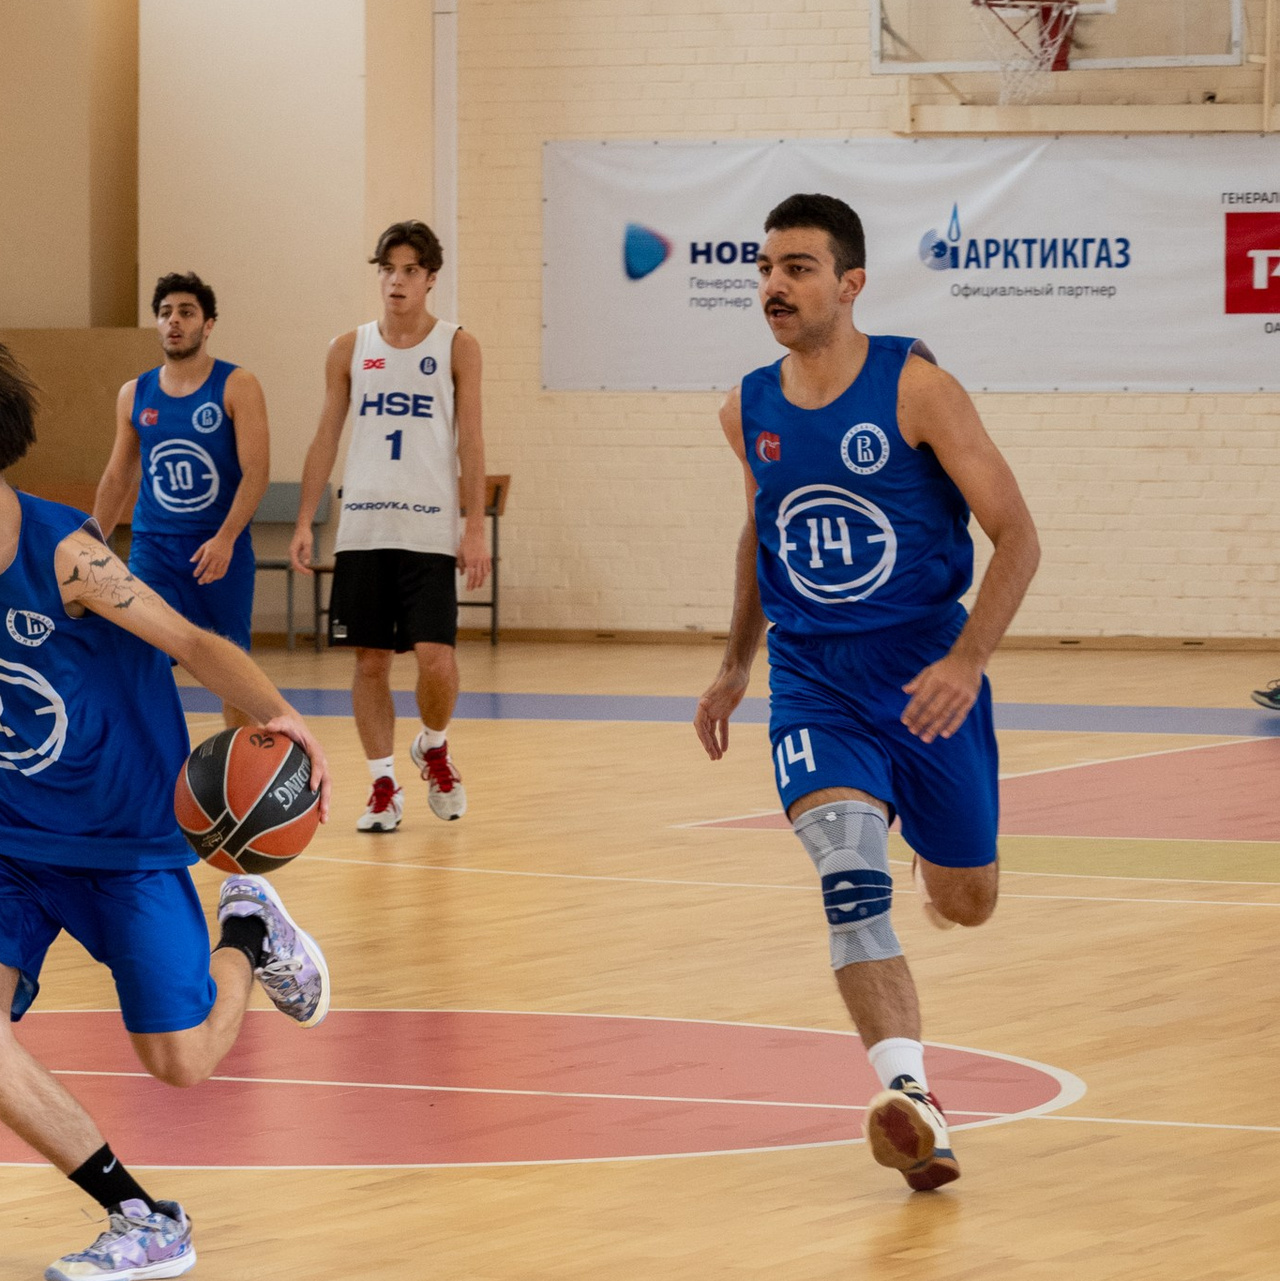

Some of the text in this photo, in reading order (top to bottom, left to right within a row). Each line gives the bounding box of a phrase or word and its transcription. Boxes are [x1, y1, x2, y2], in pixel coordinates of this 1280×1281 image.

[1222, 192, 1280, 204] ГЕНЕРАЛ
[964, 238, 1131, 269] АРКТИКГАЗ
[689, 297, 753, 310] партнер
[951, 283, 1117, 298] Официальный партнер
[360, 392, 434, 418] HSE
[385, 430, 403, 460] 1
[165, 461, 193, 491] 10
[345, 501, 441, 514] POKROVKA CUP
[806, 517, 853, 568] 14
[777, 728, 816, 789] 14
